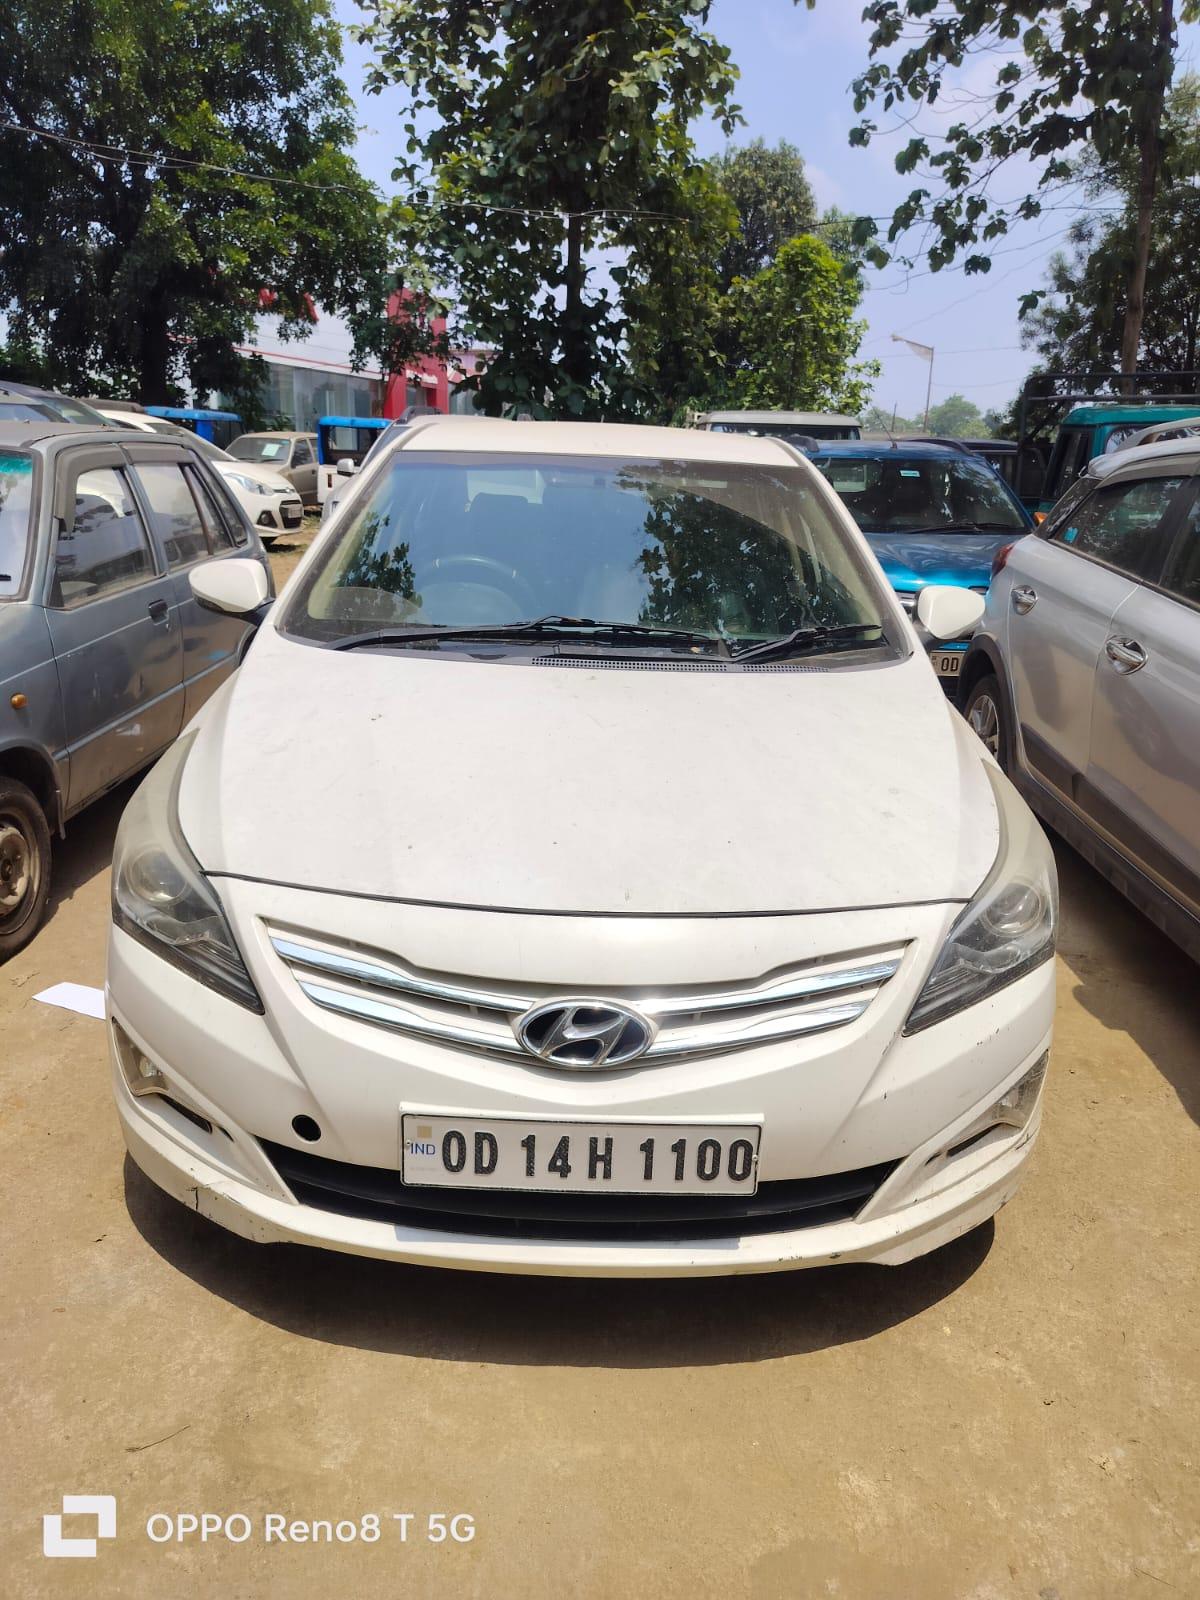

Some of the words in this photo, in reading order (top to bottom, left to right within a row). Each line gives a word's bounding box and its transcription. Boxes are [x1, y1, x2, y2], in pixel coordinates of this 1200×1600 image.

[941, 657, 959, 672] OD
[410, 1142, 436, 1155] IND
[442, 1130, 498, 1174] OD
[521, 1134, 572, 1178] 14
[588, 1136, 614, 1179] H
[640, 1138, 754, 1181] 1100
